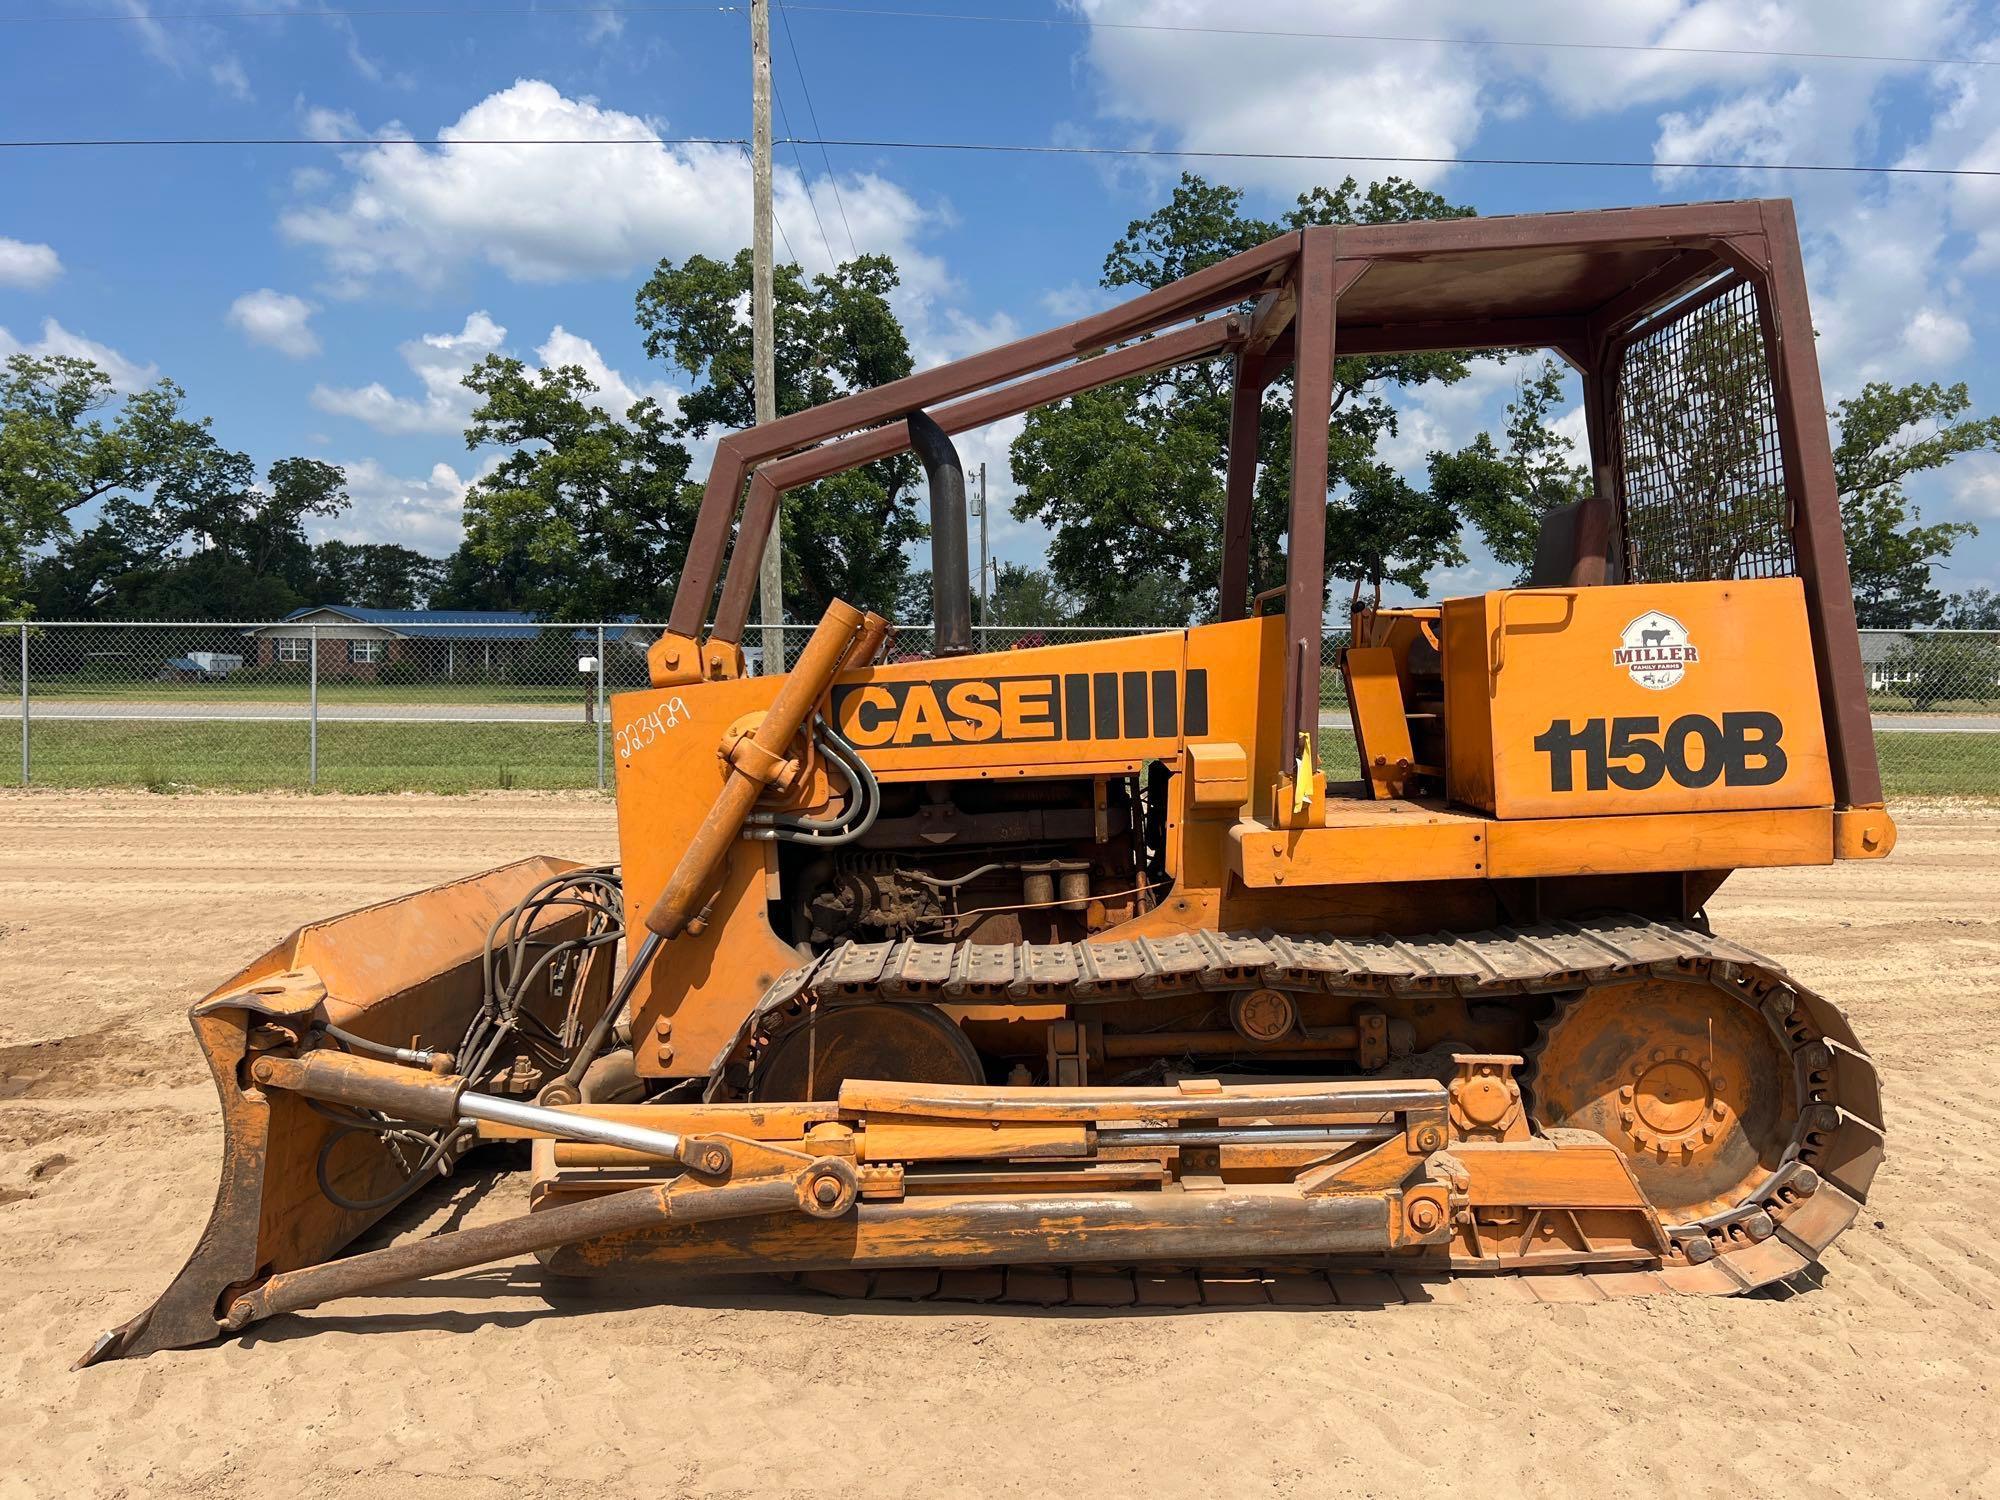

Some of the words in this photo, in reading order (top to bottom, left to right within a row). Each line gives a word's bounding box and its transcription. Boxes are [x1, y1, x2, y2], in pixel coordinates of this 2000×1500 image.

[1615, 647, 1697, 664] MILLER
[616, 696, 691, 759] 223429
[839, 679, 1055, 746] CASE
[1533, 711, 1788, 792] 1150B
